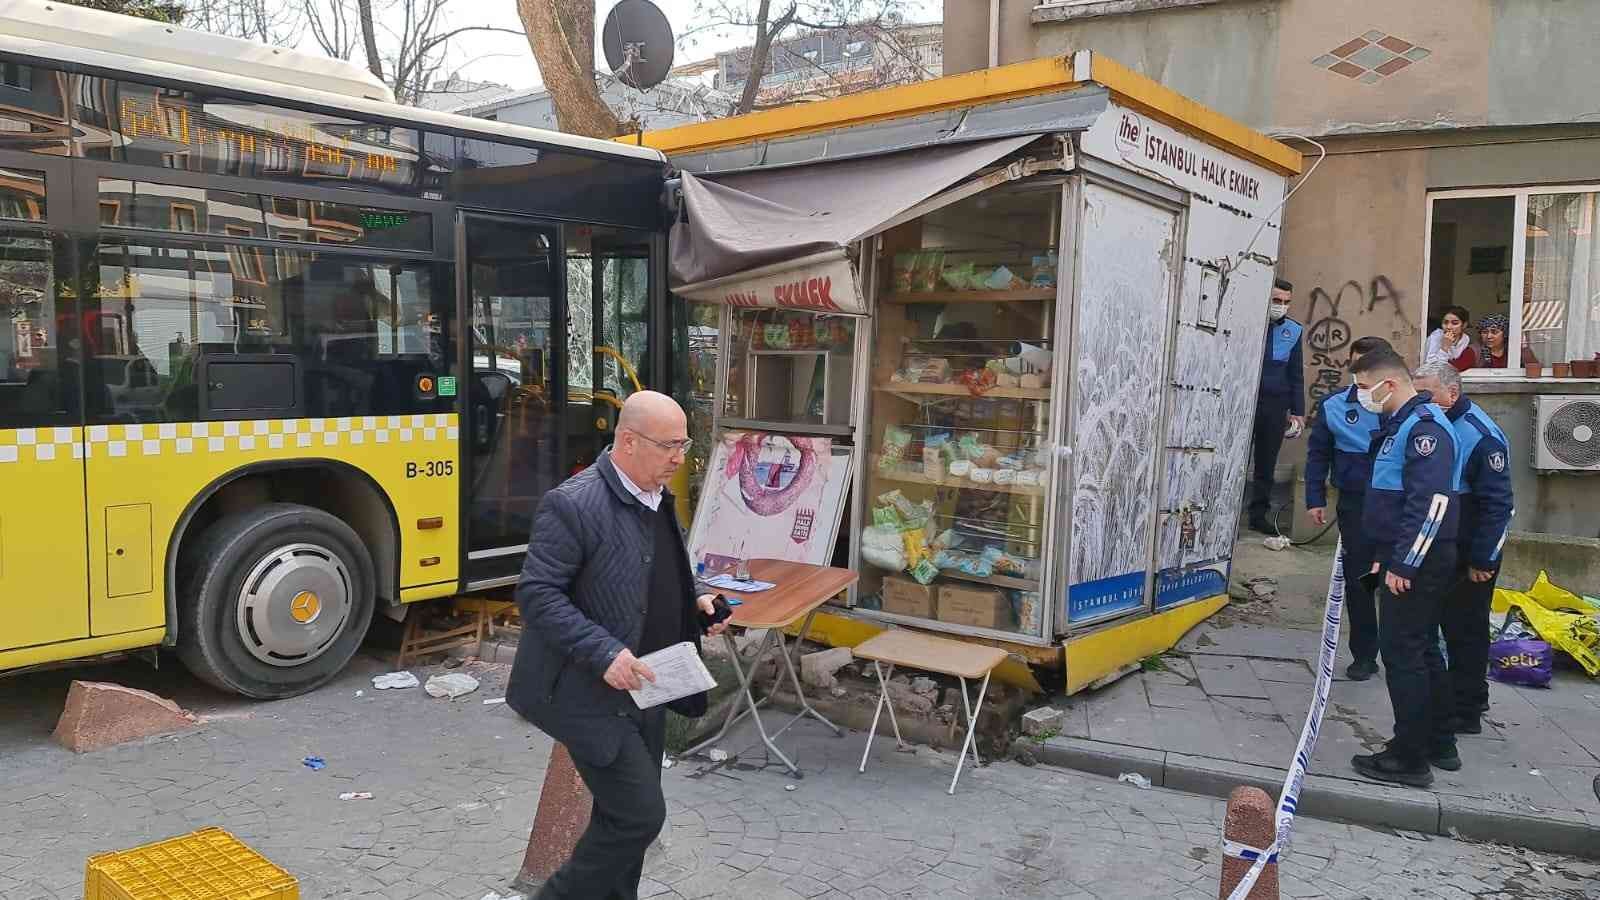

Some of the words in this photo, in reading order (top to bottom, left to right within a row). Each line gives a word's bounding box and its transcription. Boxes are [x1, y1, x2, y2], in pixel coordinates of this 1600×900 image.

[1119, 114, 1139, 142] ihe
[1144, 127, 1198, 177] İSTANBUL
[1201, 157, 1227, 188] HALK
[1229, 170, 1260, 200] EKMEK
[406, 460, 453, 478] B-305
